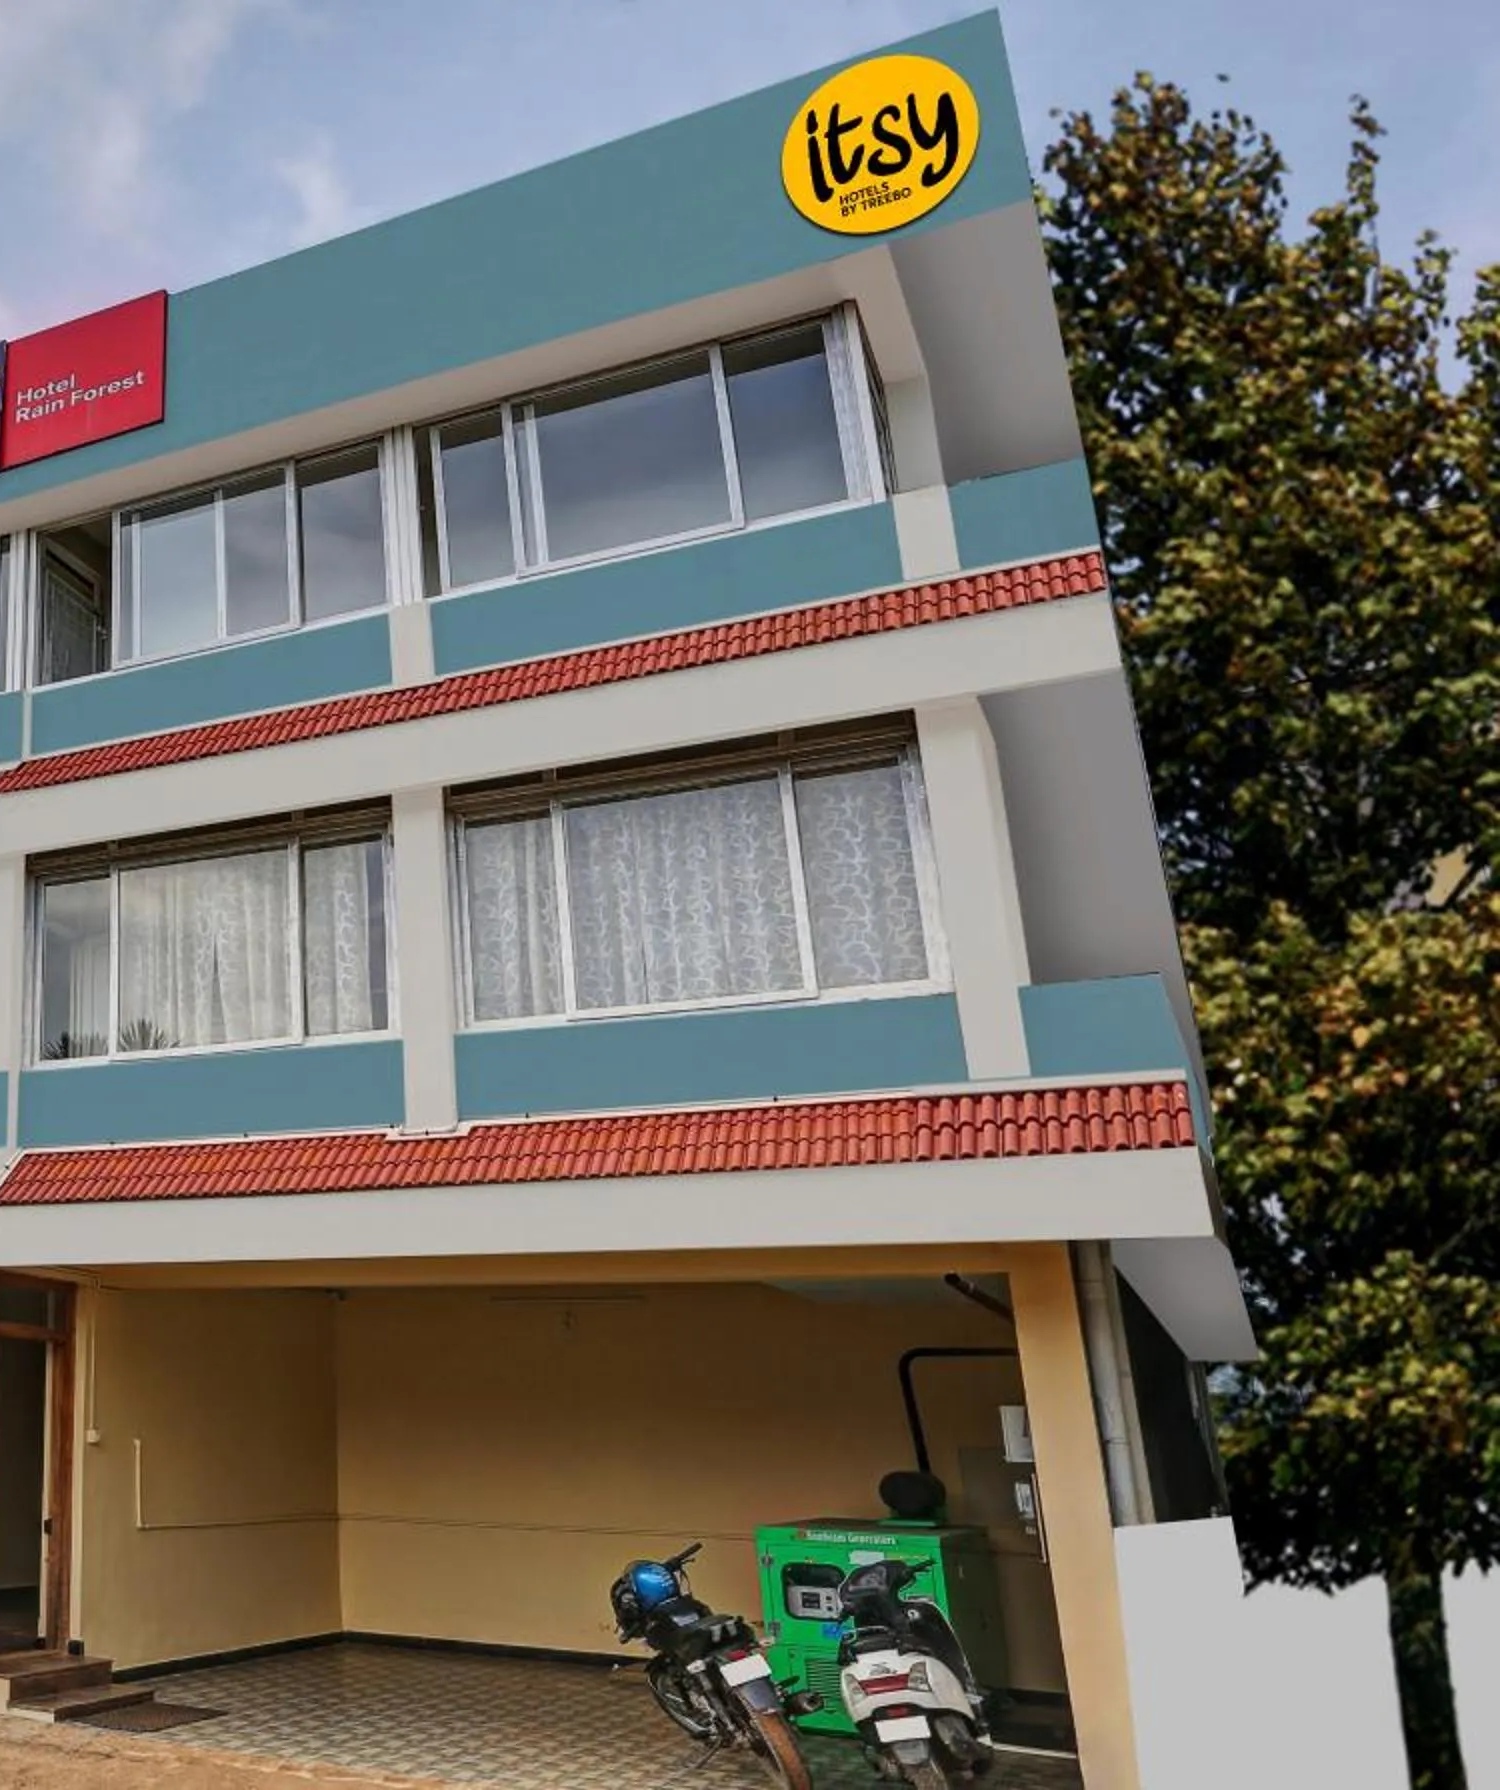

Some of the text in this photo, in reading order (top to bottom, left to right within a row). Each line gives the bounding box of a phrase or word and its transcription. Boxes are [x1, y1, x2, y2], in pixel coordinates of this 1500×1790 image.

[806, 91, 959, 203] itsy
[839, 181, 889, 205] HOTELS
[841, 187, 912, 217] BY TREEBO
[16, 371, 145, 423] Rain Forest
[17, 373, 76, 405] Hotel
